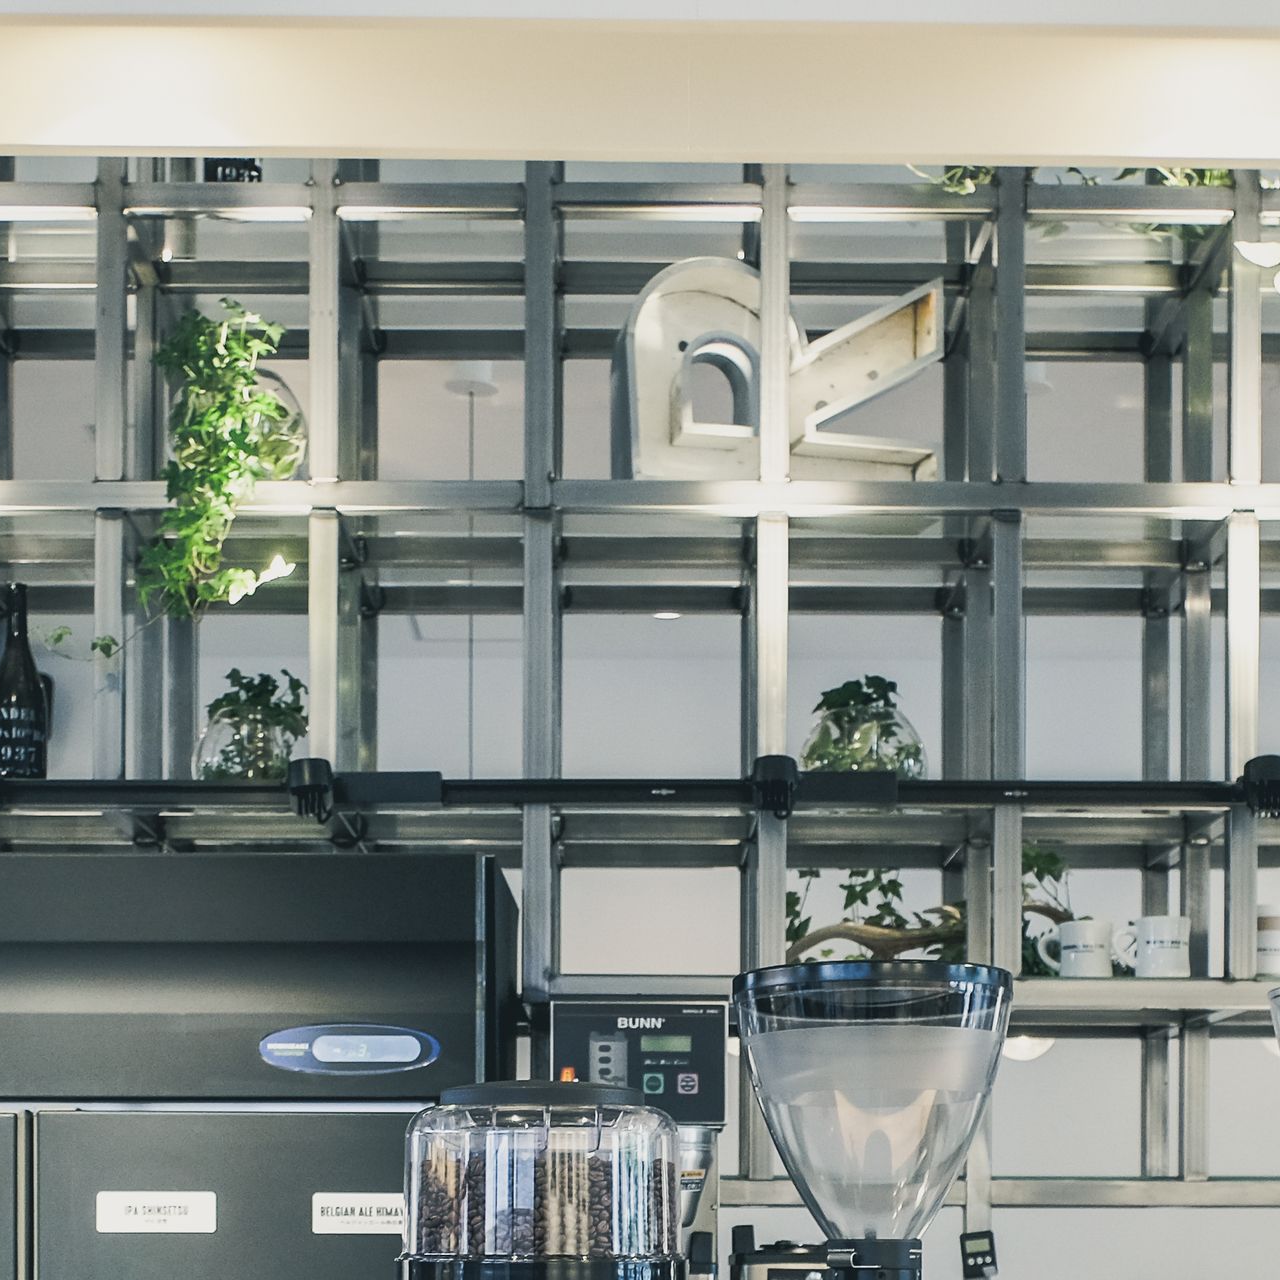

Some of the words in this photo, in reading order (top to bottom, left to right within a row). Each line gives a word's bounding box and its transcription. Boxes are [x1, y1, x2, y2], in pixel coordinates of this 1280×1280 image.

[617, 1017, 662, 1029] BUNN
[320, 1206, 356, 1217] BELGIAN
[359, 1206, 373, 1217] ALE
